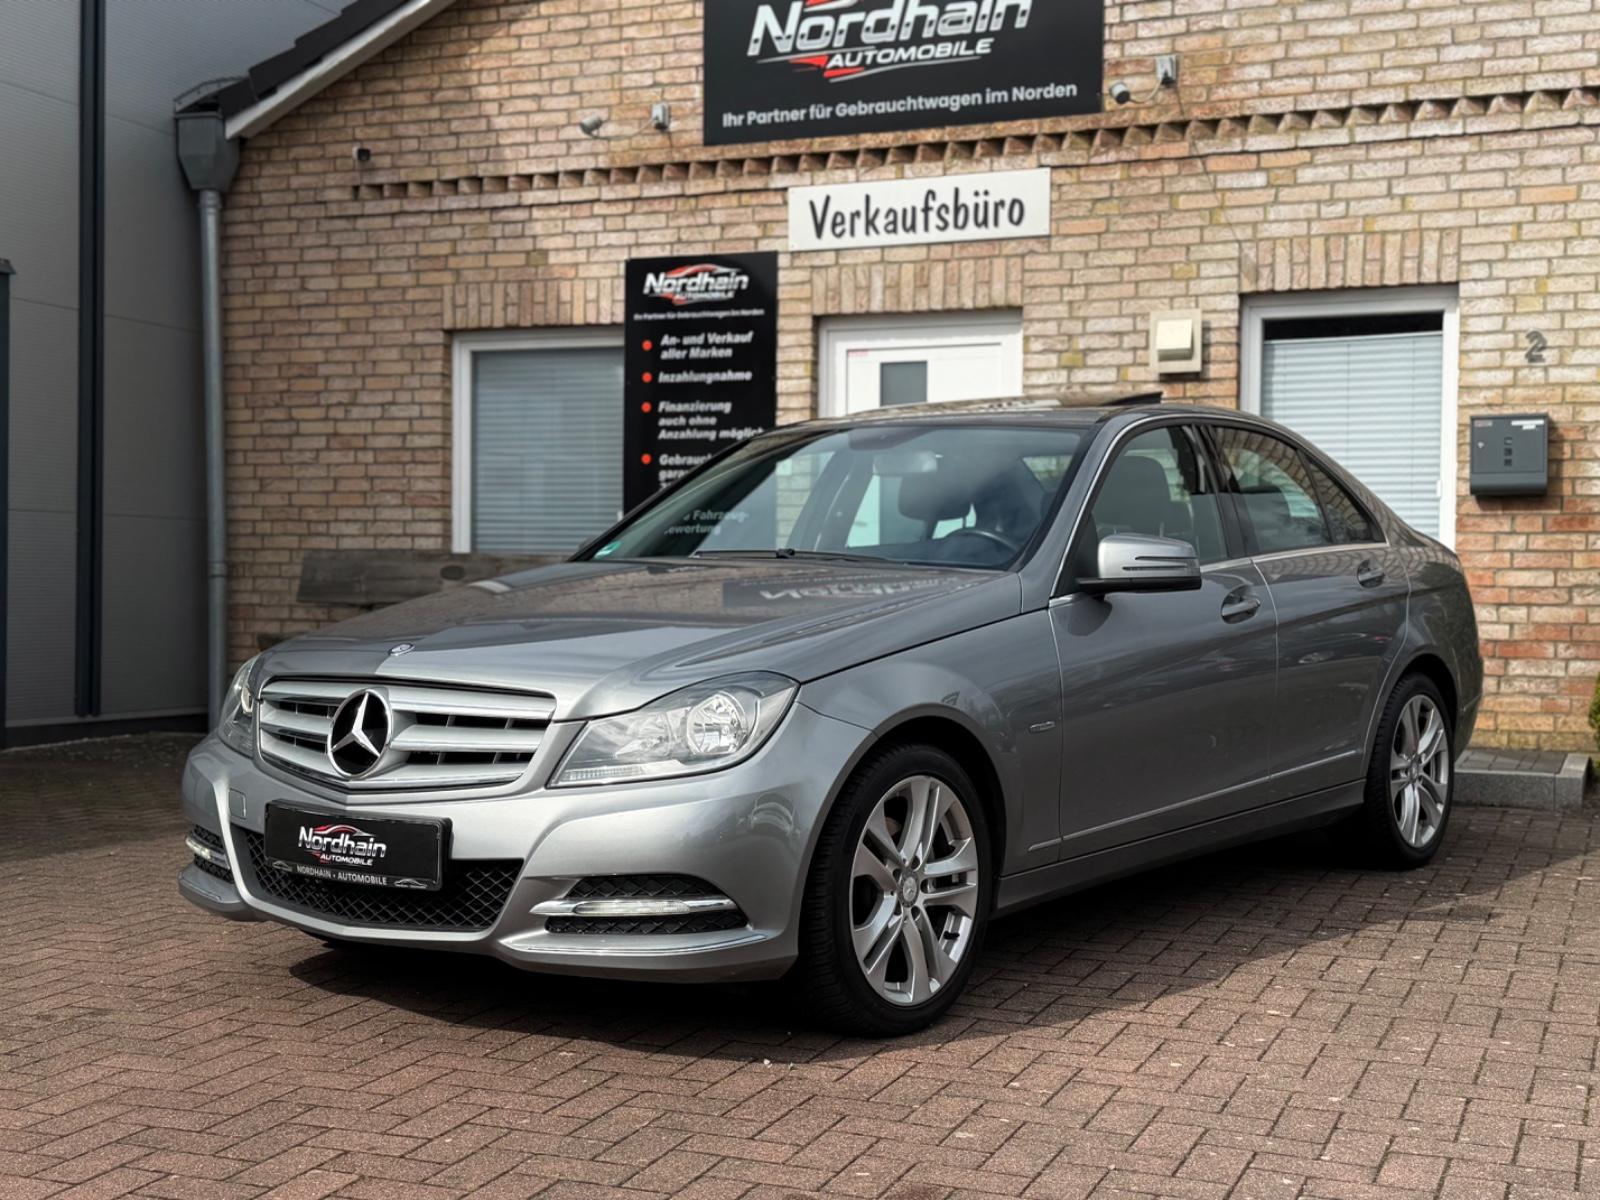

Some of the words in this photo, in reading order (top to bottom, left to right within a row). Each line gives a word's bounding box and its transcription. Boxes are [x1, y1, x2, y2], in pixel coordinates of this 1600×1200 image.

[747, 0, 1032, 56] Nordhain
[826, 38, 995, 69] AUTOMOBILE
[722, 112, 744, 128] Ihr
[747, 107, 806, 126] Partner
[809, 103, 833, 119] für
[835, 93, 982, 117] Gebrauchtwagen
[985, 88, 1009, 104] im
[1012, 83, 1078, 102] Norden
[809, 187, 1025, 240] Verkaufsbüro
[643, 271, 750, 295] Nordhain
[660, 334, 681, 346] An-
[682, 332, 705, 346] und
[707, 330, 754, 345] Verkauf
[1525, 330, 1548, 363] 2
[660, 347, 688, 360] aller
[688, 346, 733, 359] Marken
[658, 369, 753, 384] Inzahlungnahme
[658, 400, 732, 414] Finanzierung
[658, 415, 687, 427] auch
[688, 415, 717, 426] ohne
[658, 428, 717, 441] Anzahlung
[664, 525, 721, 535] ewertung
[298, 825, 387, 858] Nordhain
[320, 853, 374, 866] AUTOMOBILE
[296, 865, 332, 878] NORDHAIN
[337, 871, 388, 886] AUTOMOBILE
